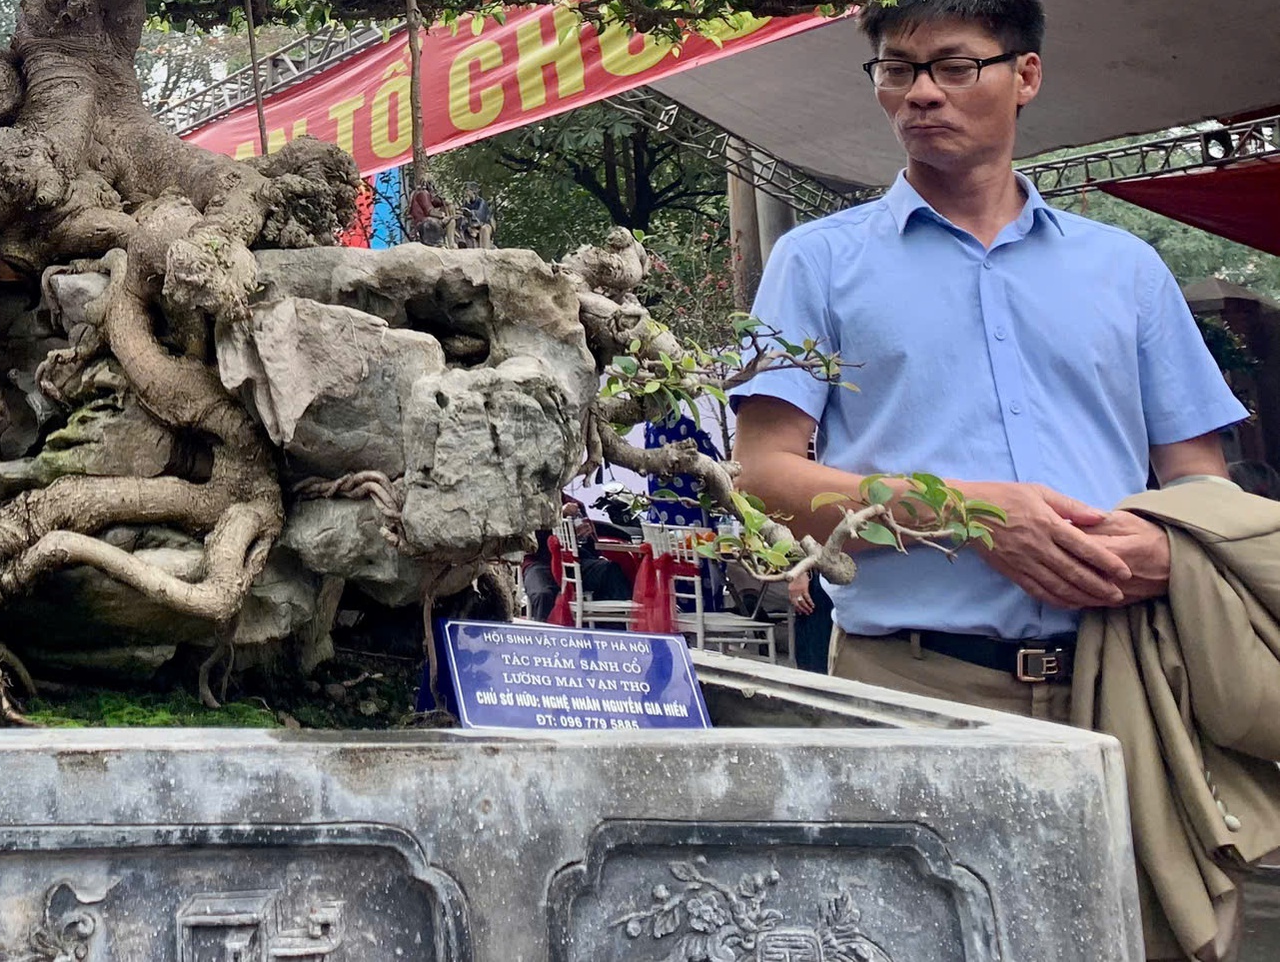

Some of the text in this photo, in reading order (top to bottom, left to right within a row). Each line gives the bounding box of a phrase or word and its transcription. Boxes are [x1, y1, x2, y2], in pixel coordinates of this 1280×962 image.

[483, 631, 504, 645] HỘI
[506, 634, 533, 645] SINH
[535, 635, 557, 648] VẬT
[594, 640, 608, 650] TP
[610, 639, 628, 652] HÀ
[629, 641, 650, 655] NỘI
[501, 652, 642, 674] TÁC PHẨM SANH CỔ
[554, 675, 584, 688] MAI
[586, 678, 618, 692] VẠN
[620, 680, 651, 695] THỌ
[476, 687, 498, 705] CHỦ
[500, 688, 515, 706] SỞ
[515, 691, 541, 708] HỮU:
[541, 694, 570, 712] NGHỆ
[571, 695, 601, 712] NHÂN
[602, 696, 644, 714] NGUYỄN
[644, 701, 663, 716] GIA
[535, 714, 558, 727] ĐT:
[560, 716, 583, 728] 096
[585, 717, 607, 729] 779
